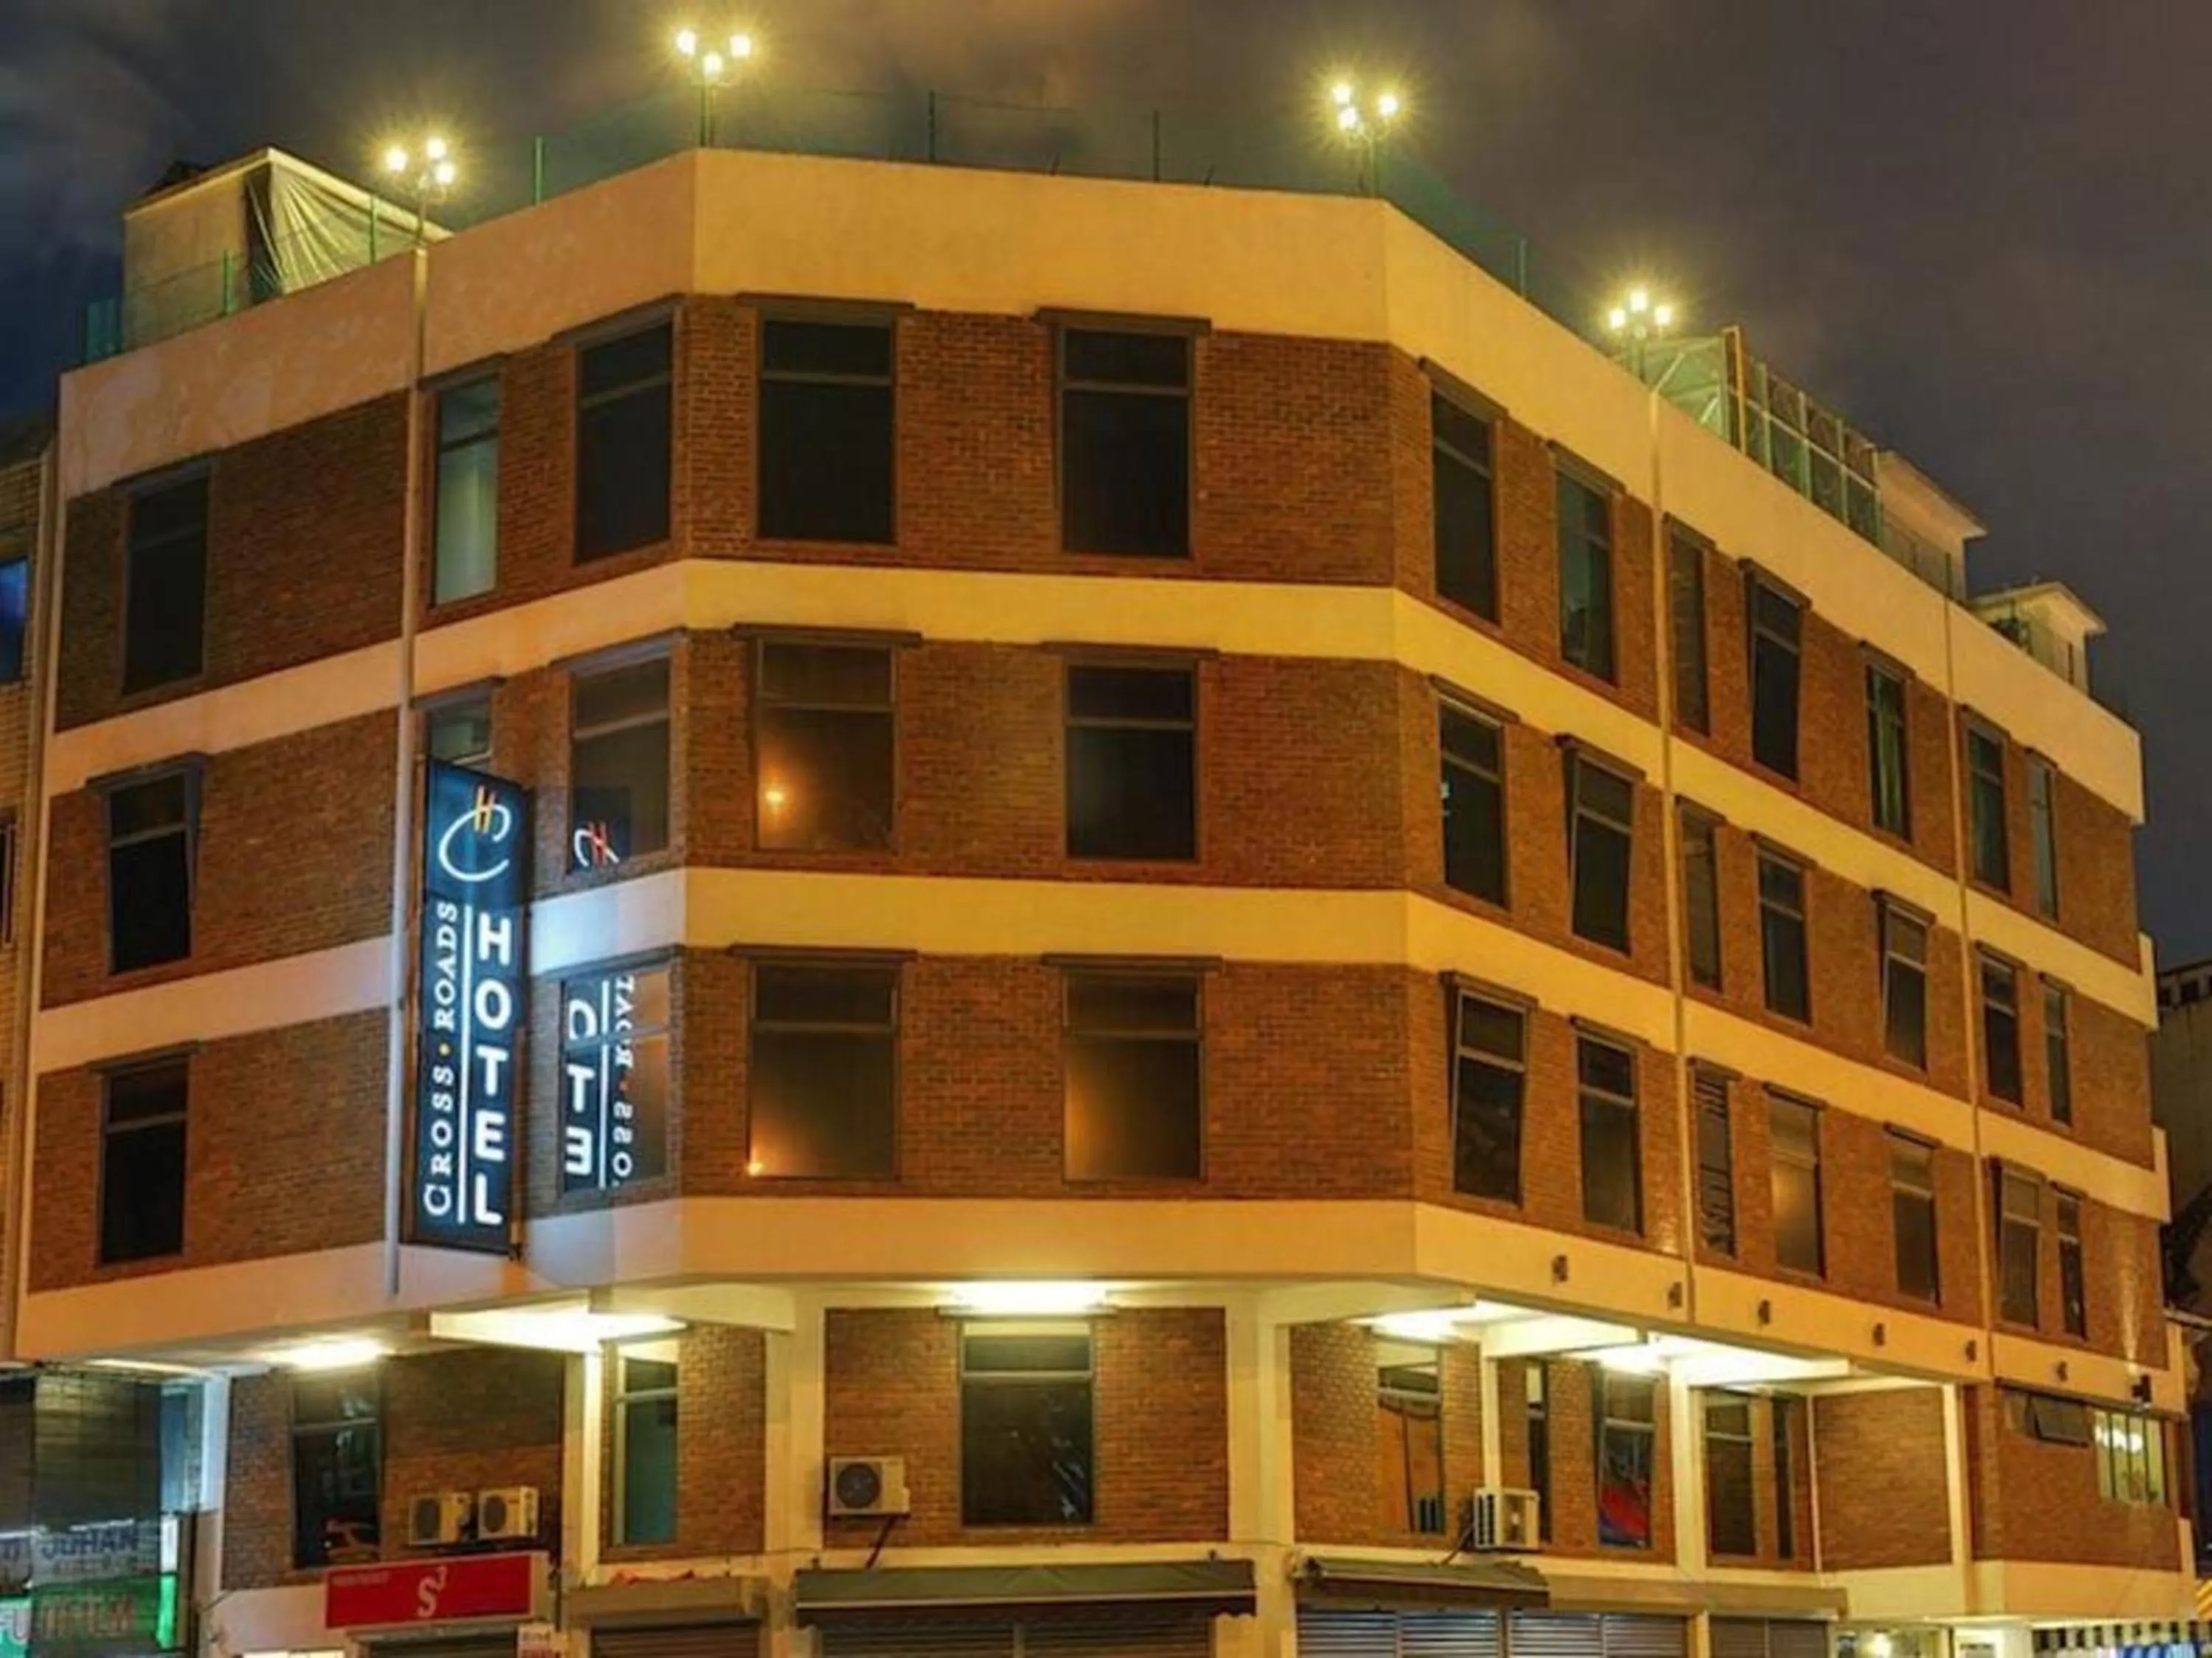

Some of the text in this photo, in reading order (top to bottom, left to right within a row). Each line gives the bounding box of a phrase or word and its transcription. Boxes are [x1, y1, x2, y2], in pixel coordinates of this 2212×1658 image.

[422, 901, 459, 1215] CROSS ROADS
[474, 912, 512, 1226] HOTEL
